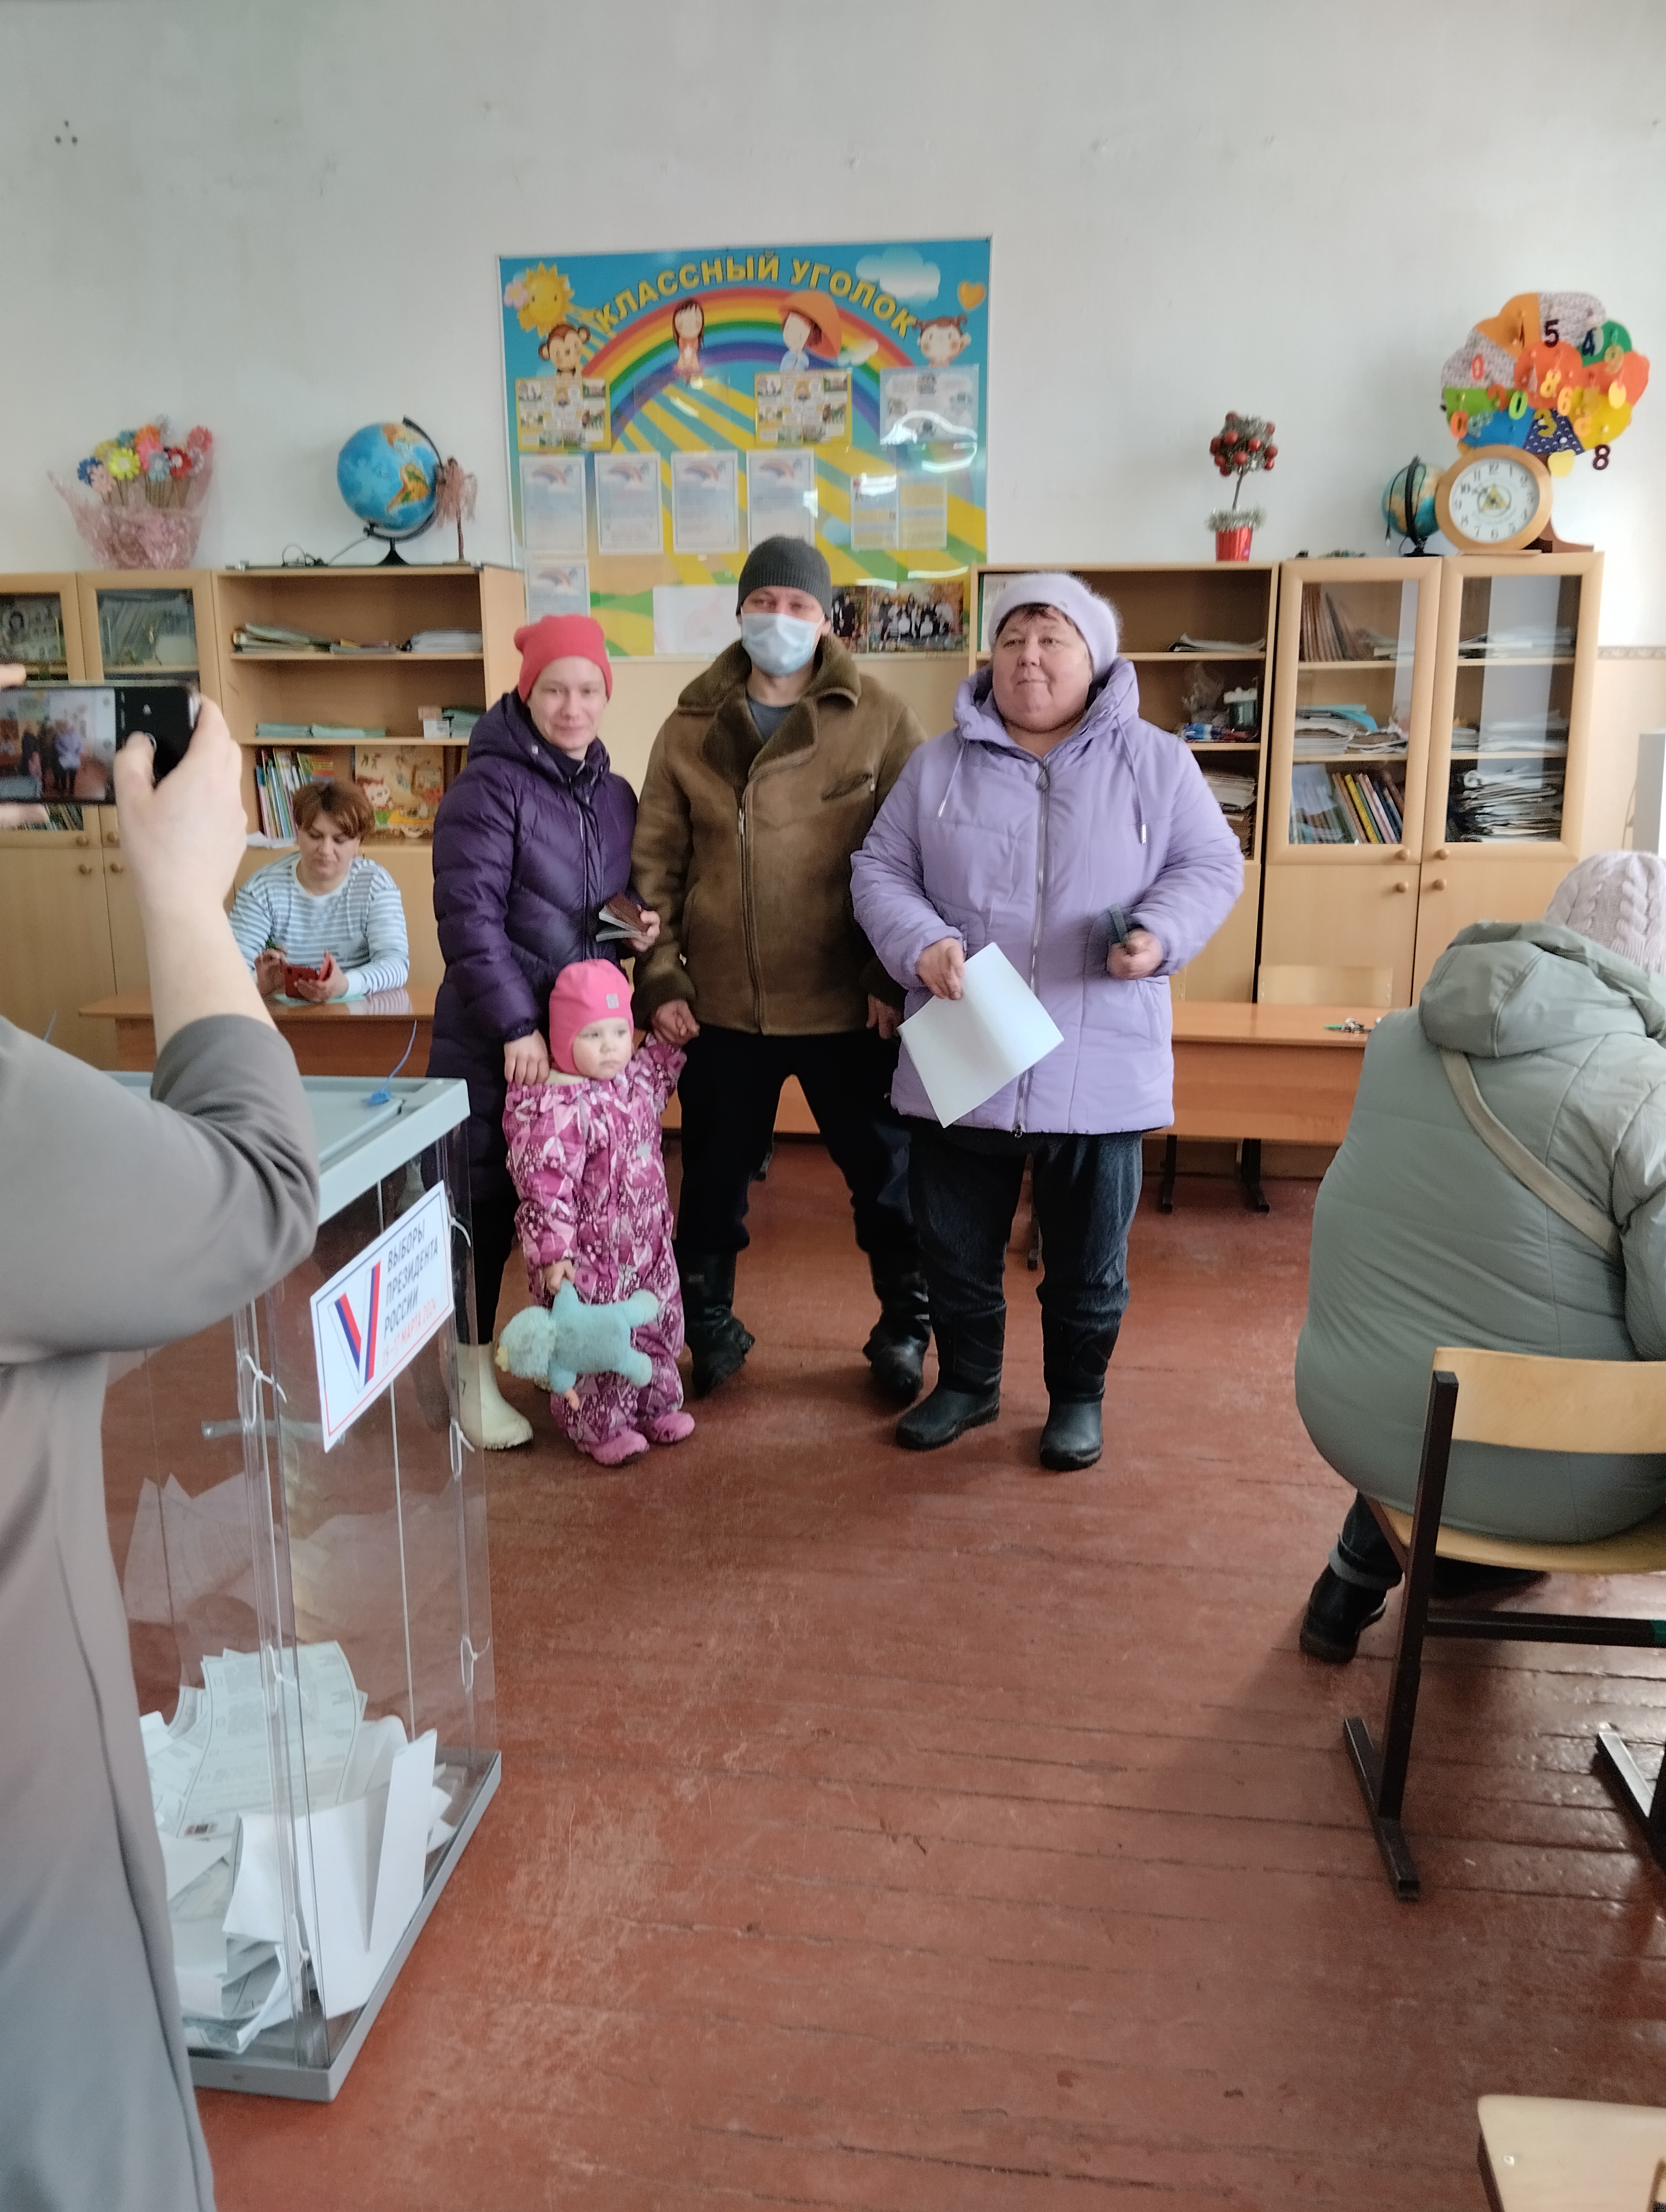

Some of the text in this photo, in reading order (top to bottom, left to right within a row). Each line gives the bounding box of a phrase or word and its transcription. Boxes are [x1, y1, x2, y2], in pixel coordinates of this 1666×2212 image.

[596, 249, 918, 339] КЛАССНЫЙ УГОЛОК
[1545, 319, 1560, 348] 5
[1581, 329, 1596, 356] 4
[1540, 369, 1561, 398] 8
[1558, 387, 1573, 416] 6
[1535, 408, 1557, 437] 3
[1489, 461, 1500, 475] 12
[1593, 445, 1610, 470] 8
[1473, 468, 1481, 481] 11
[387, 1218, 425, 1274] ВЫБОРЫ
[386, 1235, 438, 1307] ПРЕЗИДЕНТА
[384, 1284, 419, 1340] РОССИИ
[401, 1310, 421, 1347] МАРТА
